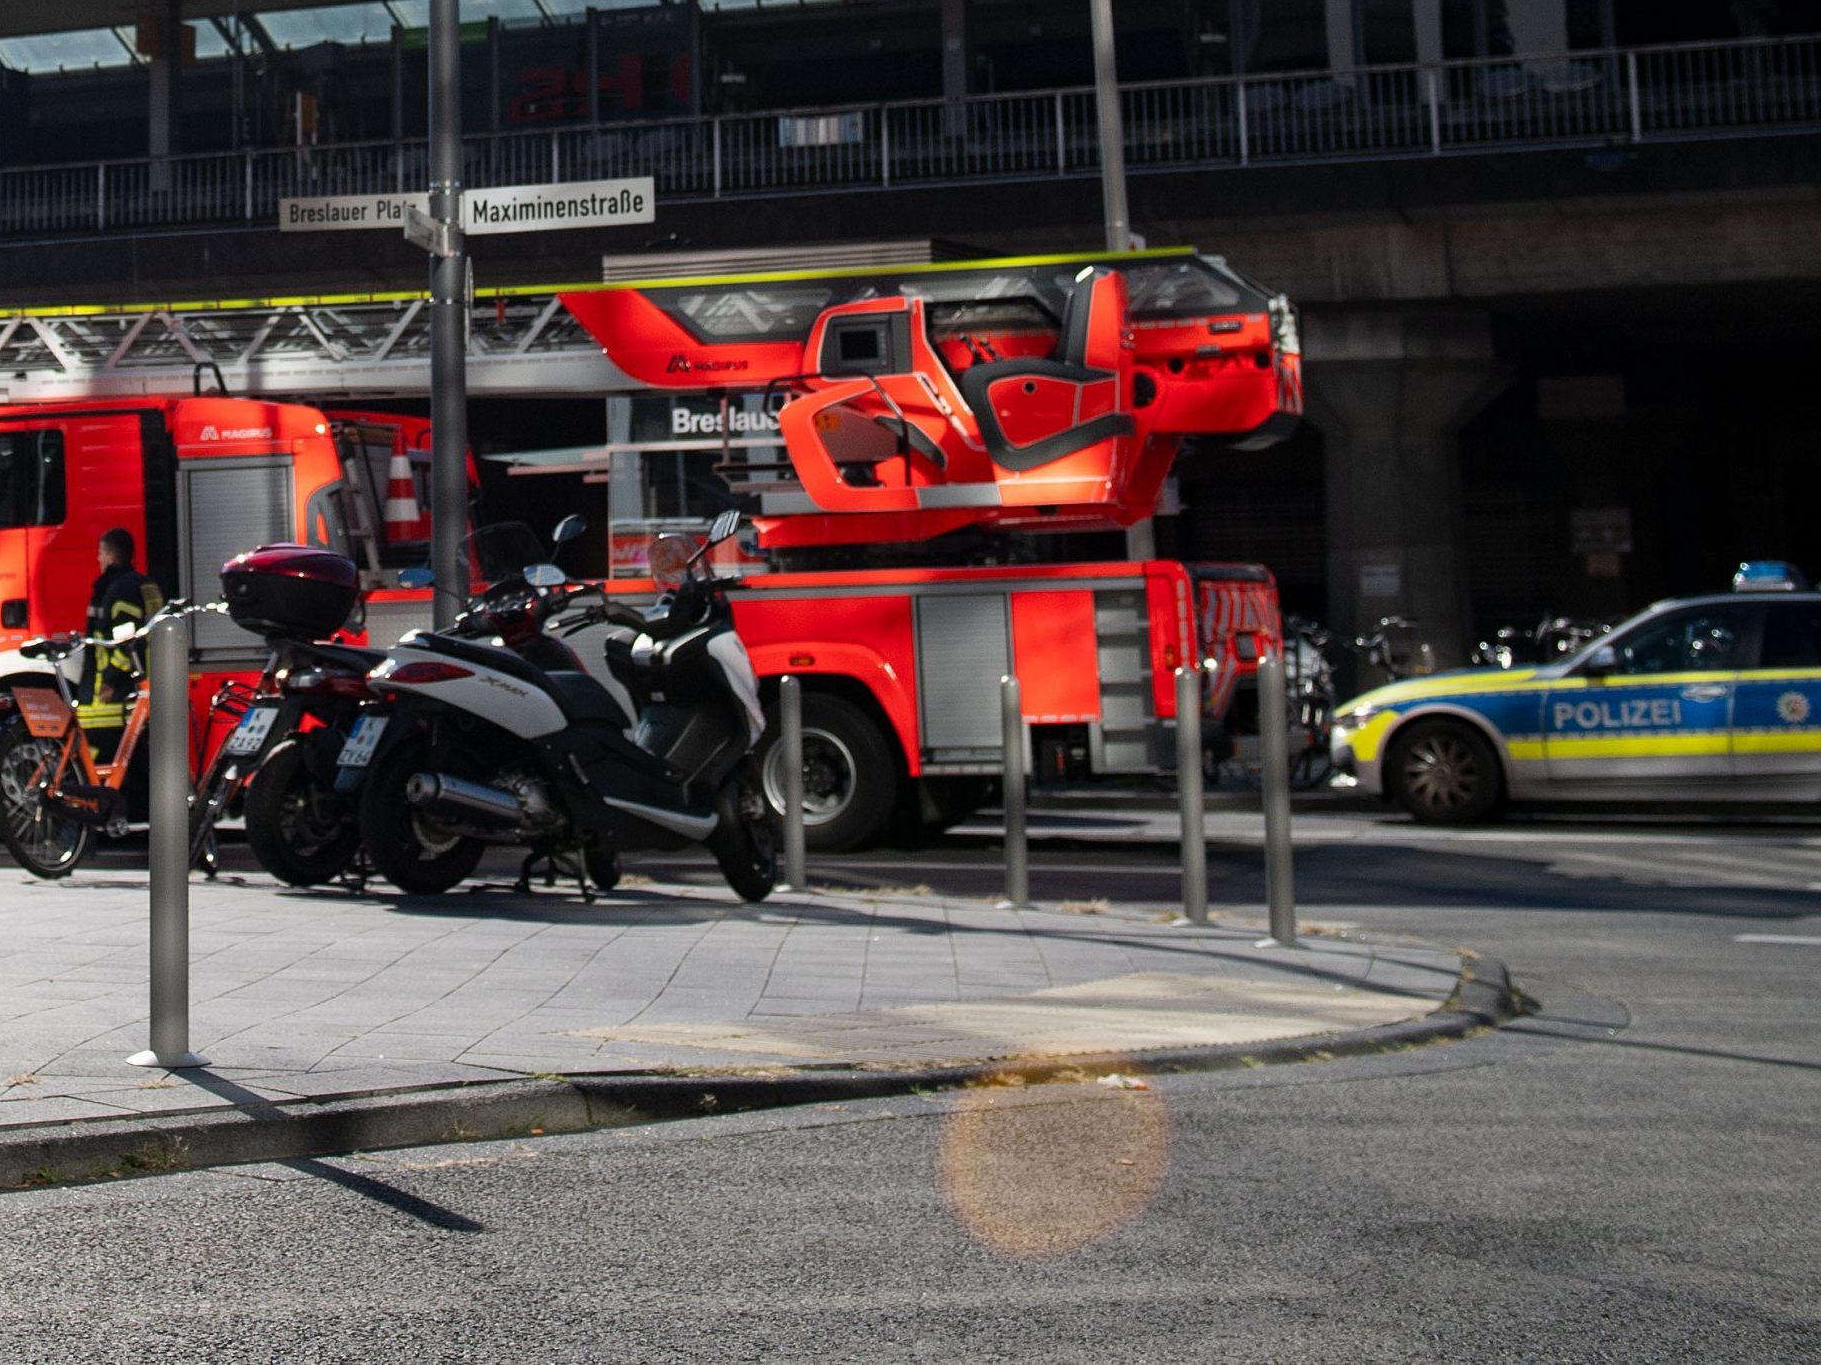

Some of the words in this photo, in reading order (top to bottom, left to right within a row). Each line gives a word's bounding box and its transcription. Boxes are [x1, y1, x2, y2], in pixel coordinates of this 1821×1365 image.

[289, 201, 368, 224] Breslauer
[377, 198, 416, 220] Pla
[473, 189, 644, 224] Maximinenstraße
[1554, 699, 1682, 730] POLIZEI
